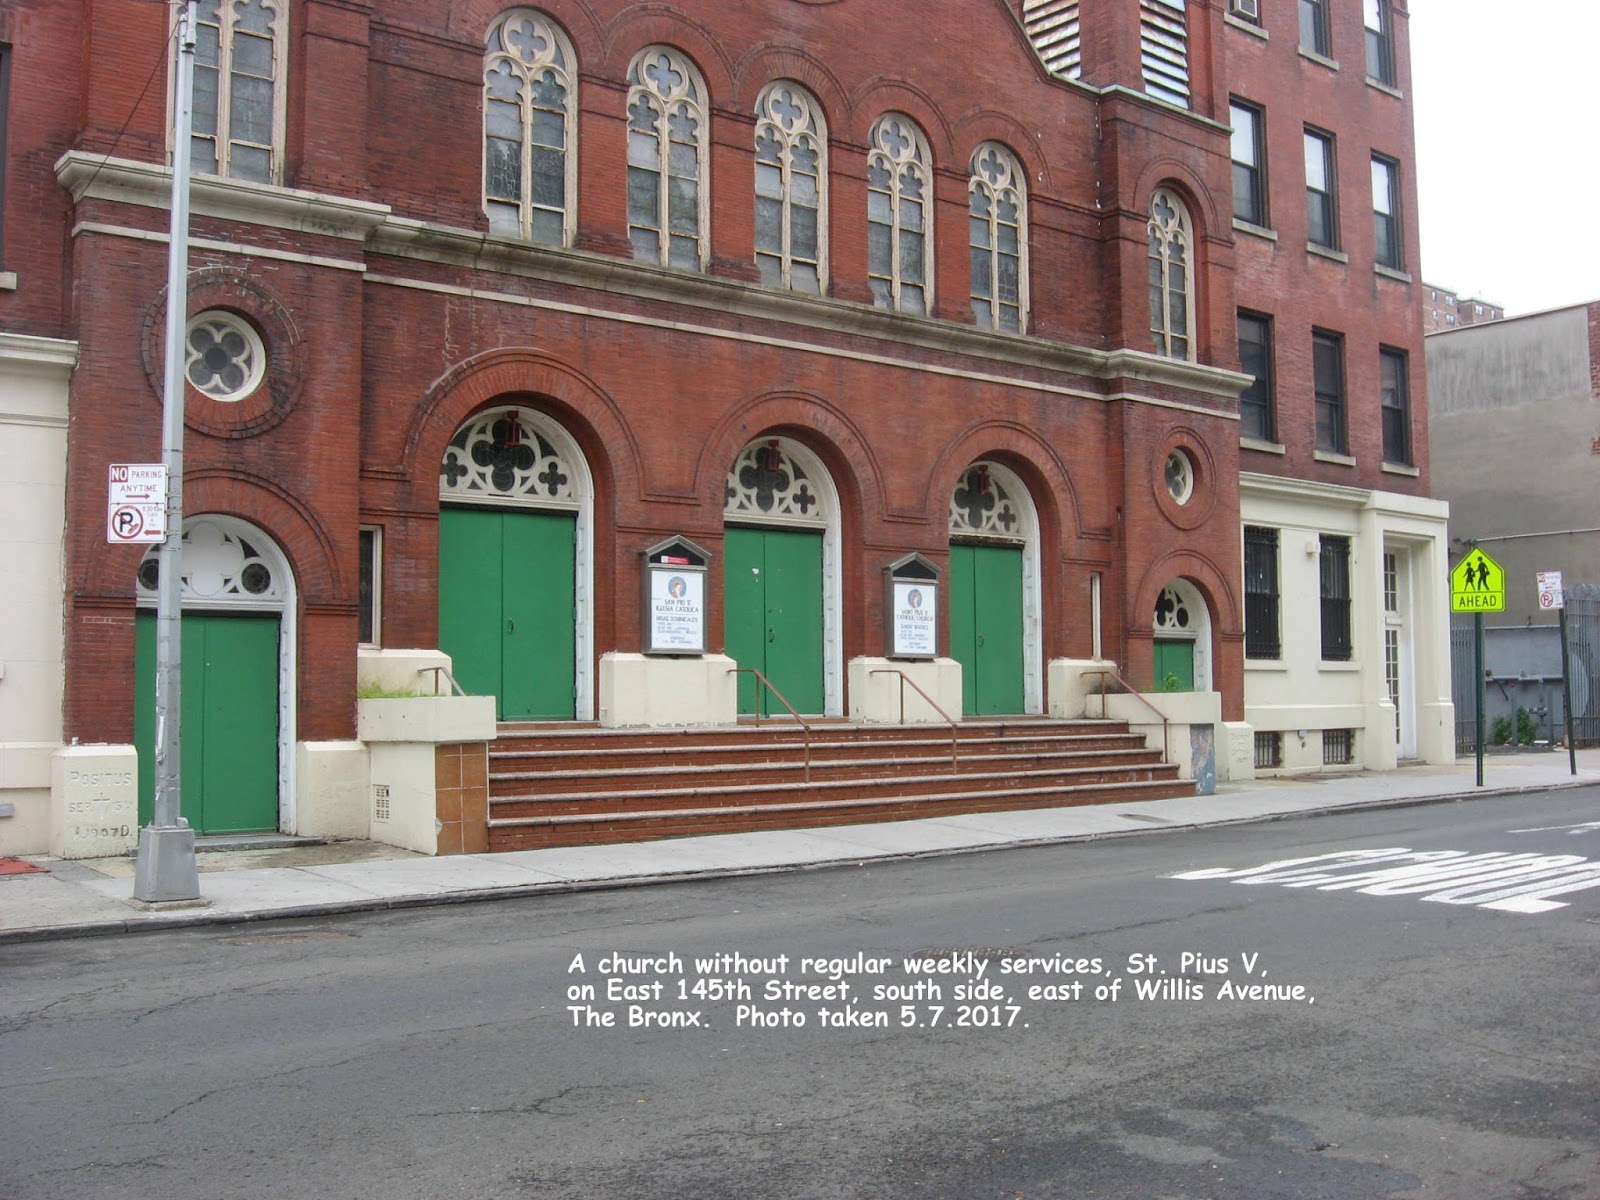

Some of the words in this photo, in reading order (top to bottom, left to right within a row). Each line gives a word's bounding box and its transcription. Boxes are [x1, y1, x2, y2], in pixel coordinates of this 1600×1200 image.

[111, 467, 128, 481] NO
[131, 470, 162, 479] PARKING
[120, 484, 157, 492] ANYTIME
[1459, 595, 1497, 607] AHEAD
